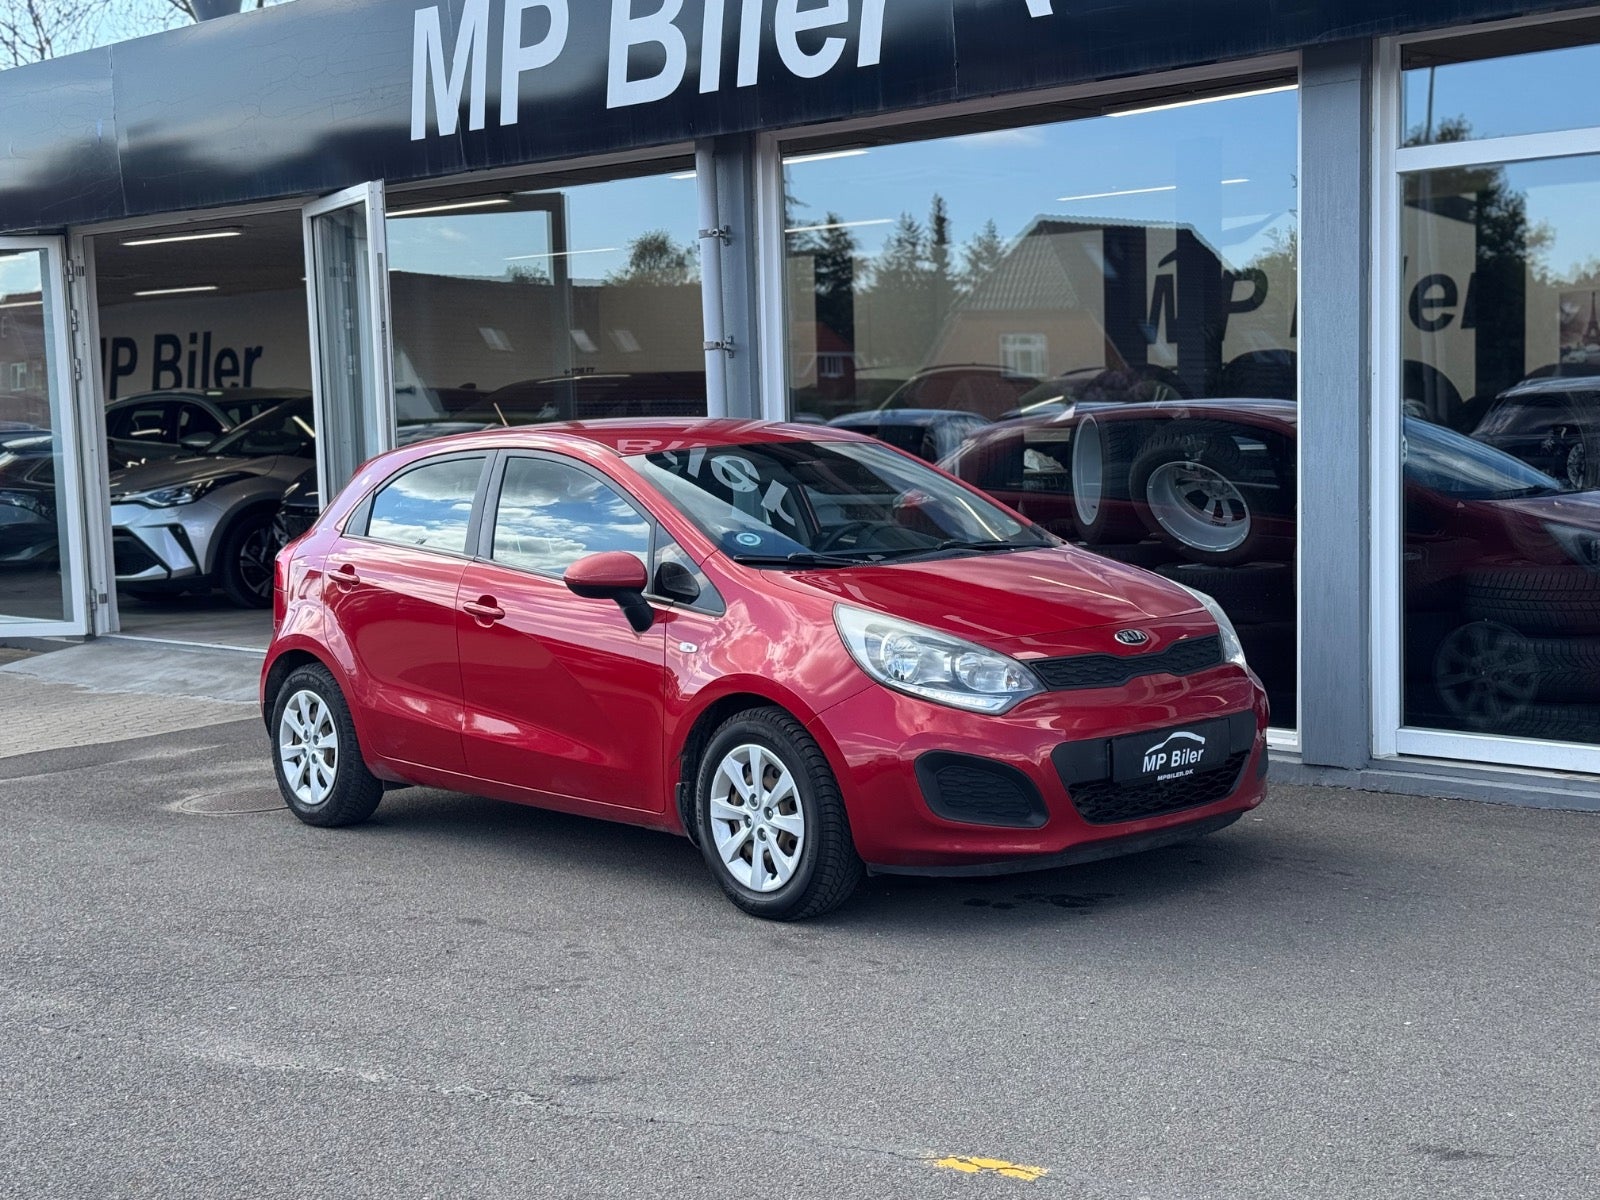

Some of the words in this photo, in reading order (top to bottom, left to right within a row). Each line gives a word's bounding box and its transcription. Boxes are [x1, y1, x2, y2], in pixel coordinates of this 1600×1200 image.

[410, 0, 570, 141] MP
[152, 331, 263, 391] Biler
[1117, 630, 1147, 643] KIA
[1142, 752, 1167, 773] MP
[1170, 748, 1204, 767] Biler
